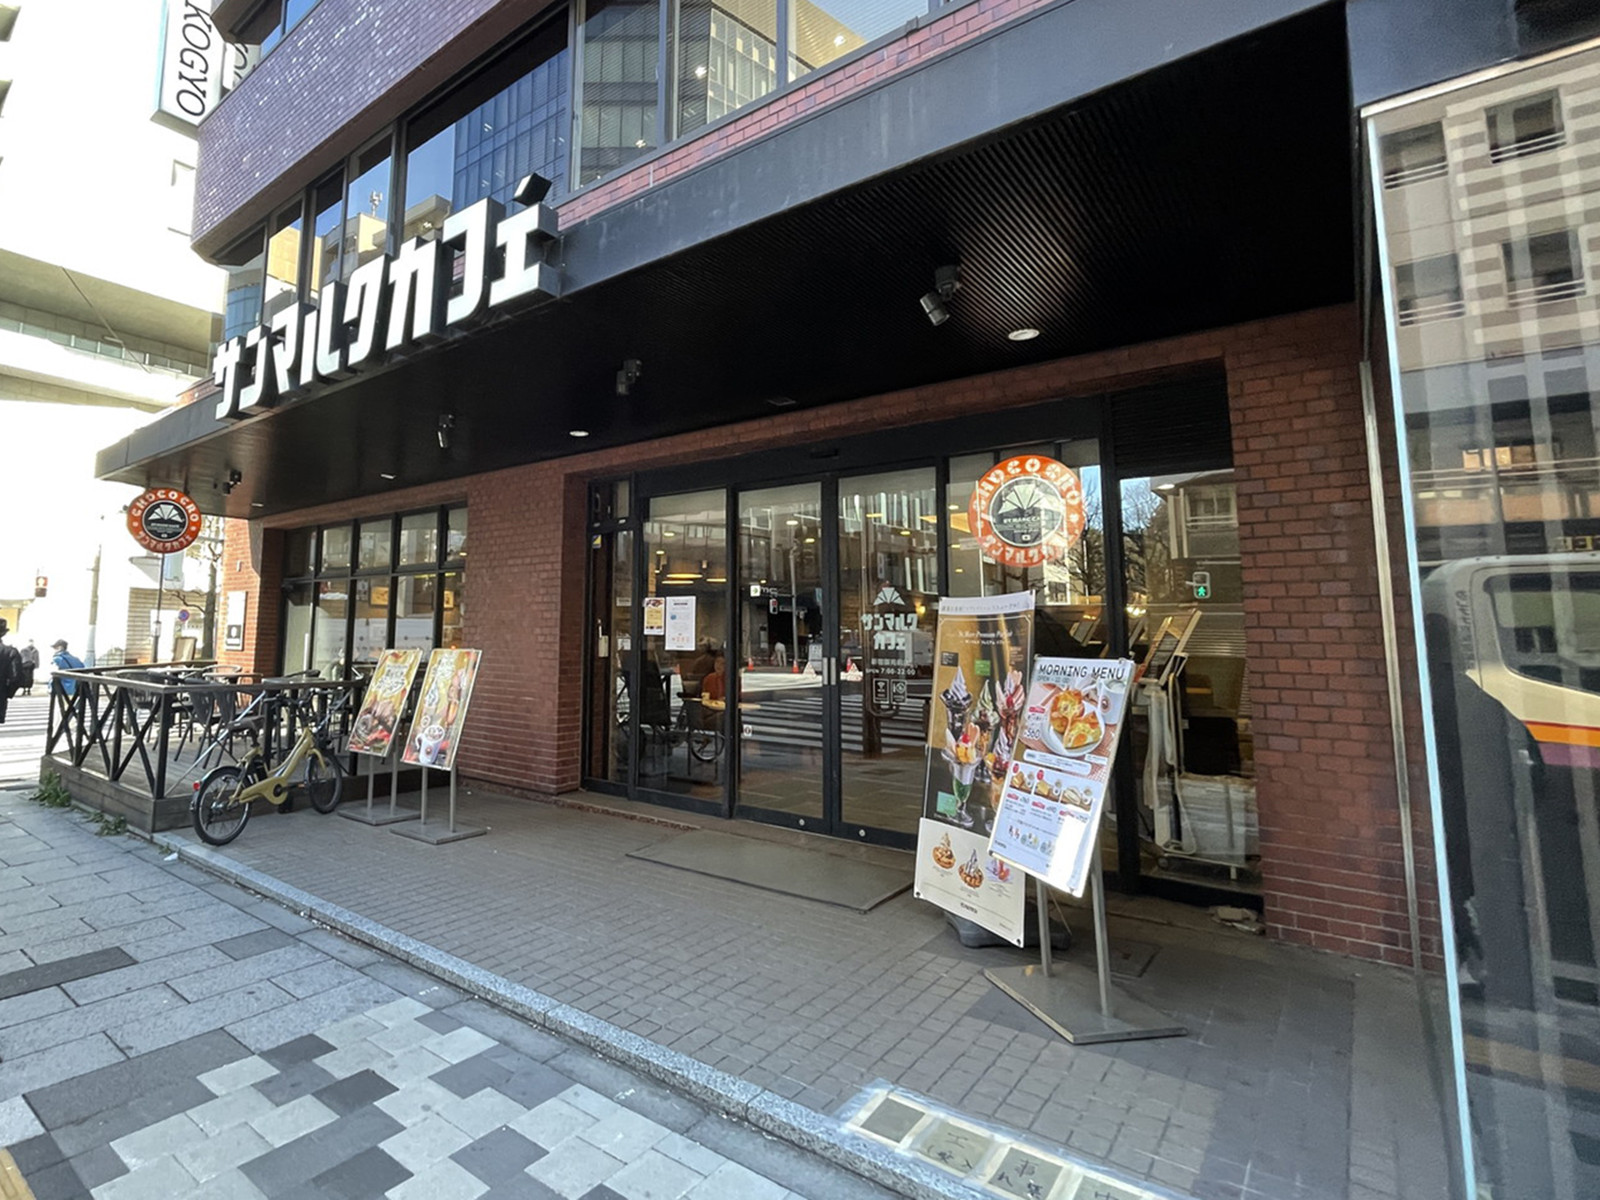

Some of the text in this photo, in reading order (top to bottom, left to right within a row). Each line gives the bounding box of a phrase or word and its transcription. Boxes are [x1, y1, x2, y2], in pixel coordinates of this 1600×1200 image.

[212, 197, 545, 421] サンマルクカフェ
[972, 458, 1041, 511] CHOCO
[131, 489, 200, 522] CHOCO CRO
[861, 613, 918, 631] サンマルク
[873, 631, 907, 650] カフェ
[1039, 663, 1125, 680] MORNING MENU
